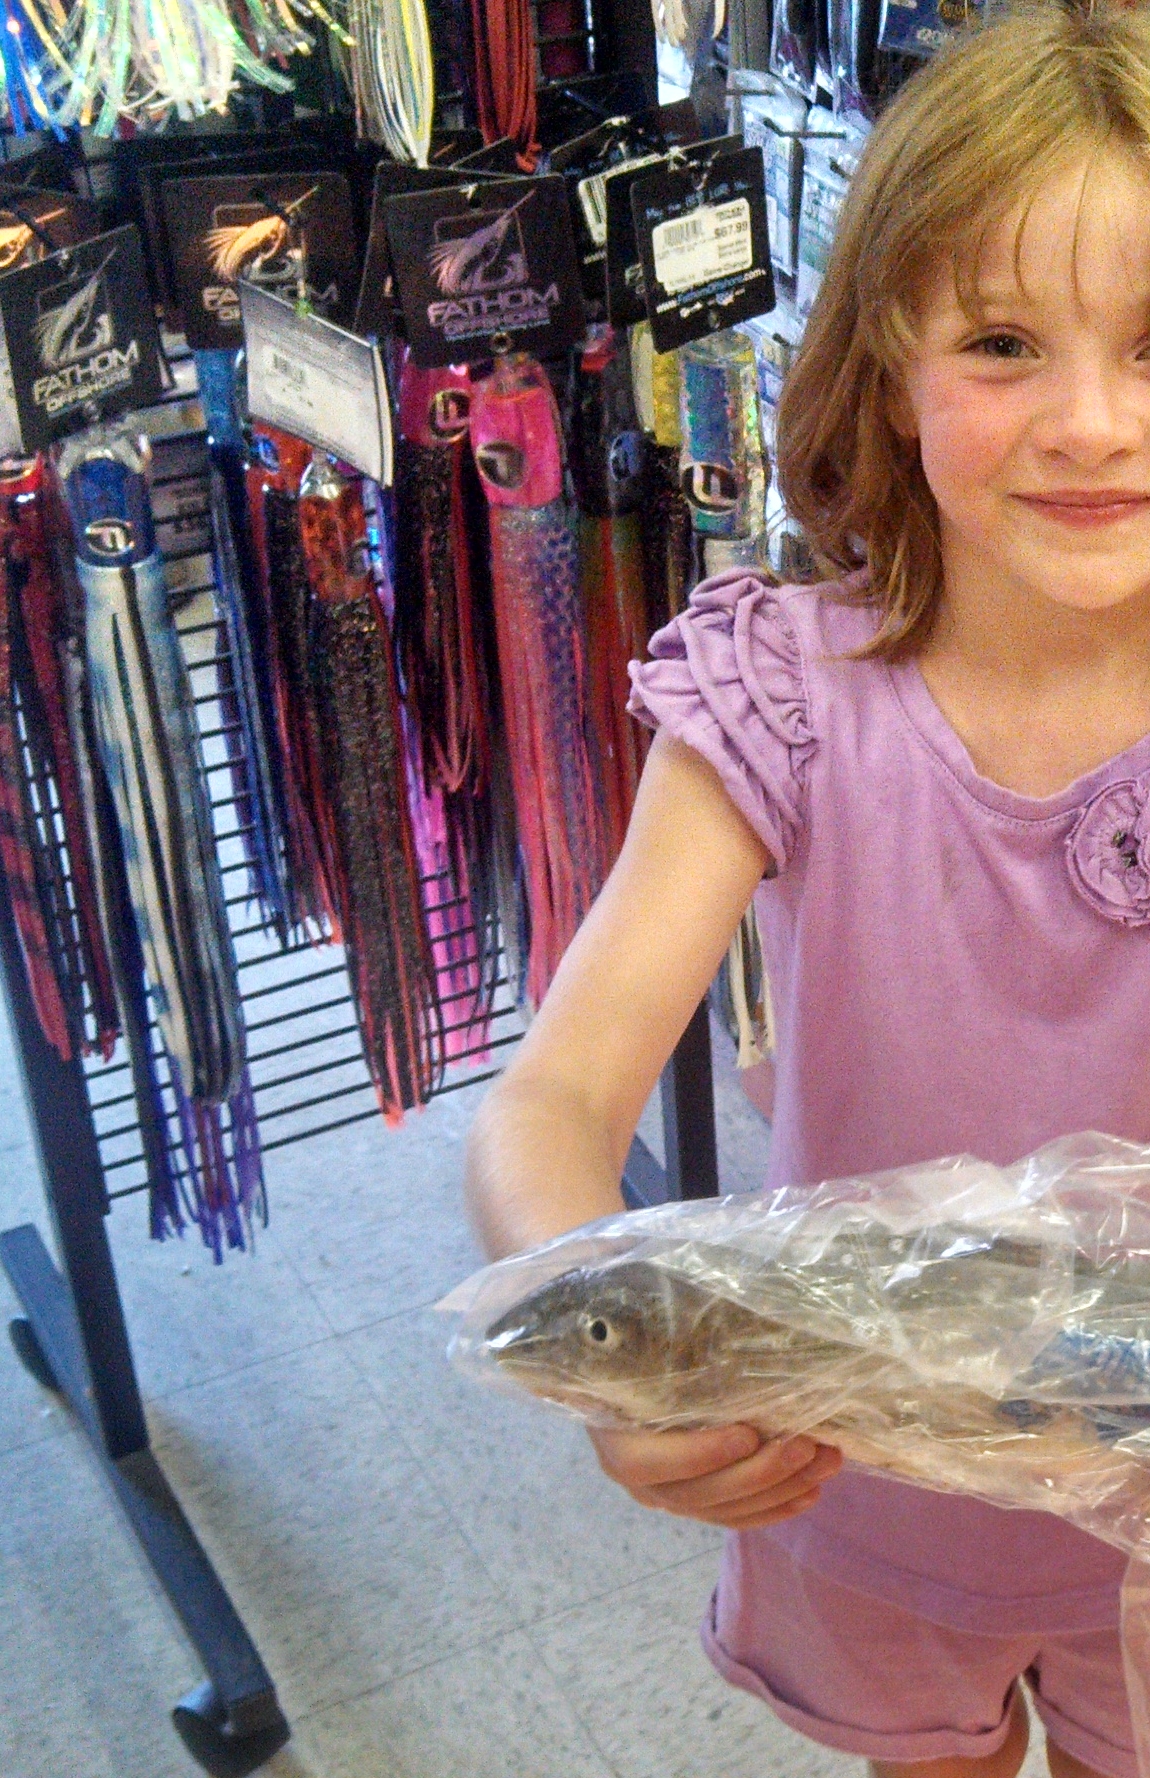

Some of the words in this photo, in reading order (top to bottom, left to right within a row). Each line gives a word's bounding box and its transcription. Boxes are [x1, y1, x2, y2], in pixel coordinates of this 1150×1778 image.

[714, 220, 748, 240] $67.99
[427, 282, 560, 328] FATHOM
[33, 340, 140, 405] FATHOM
